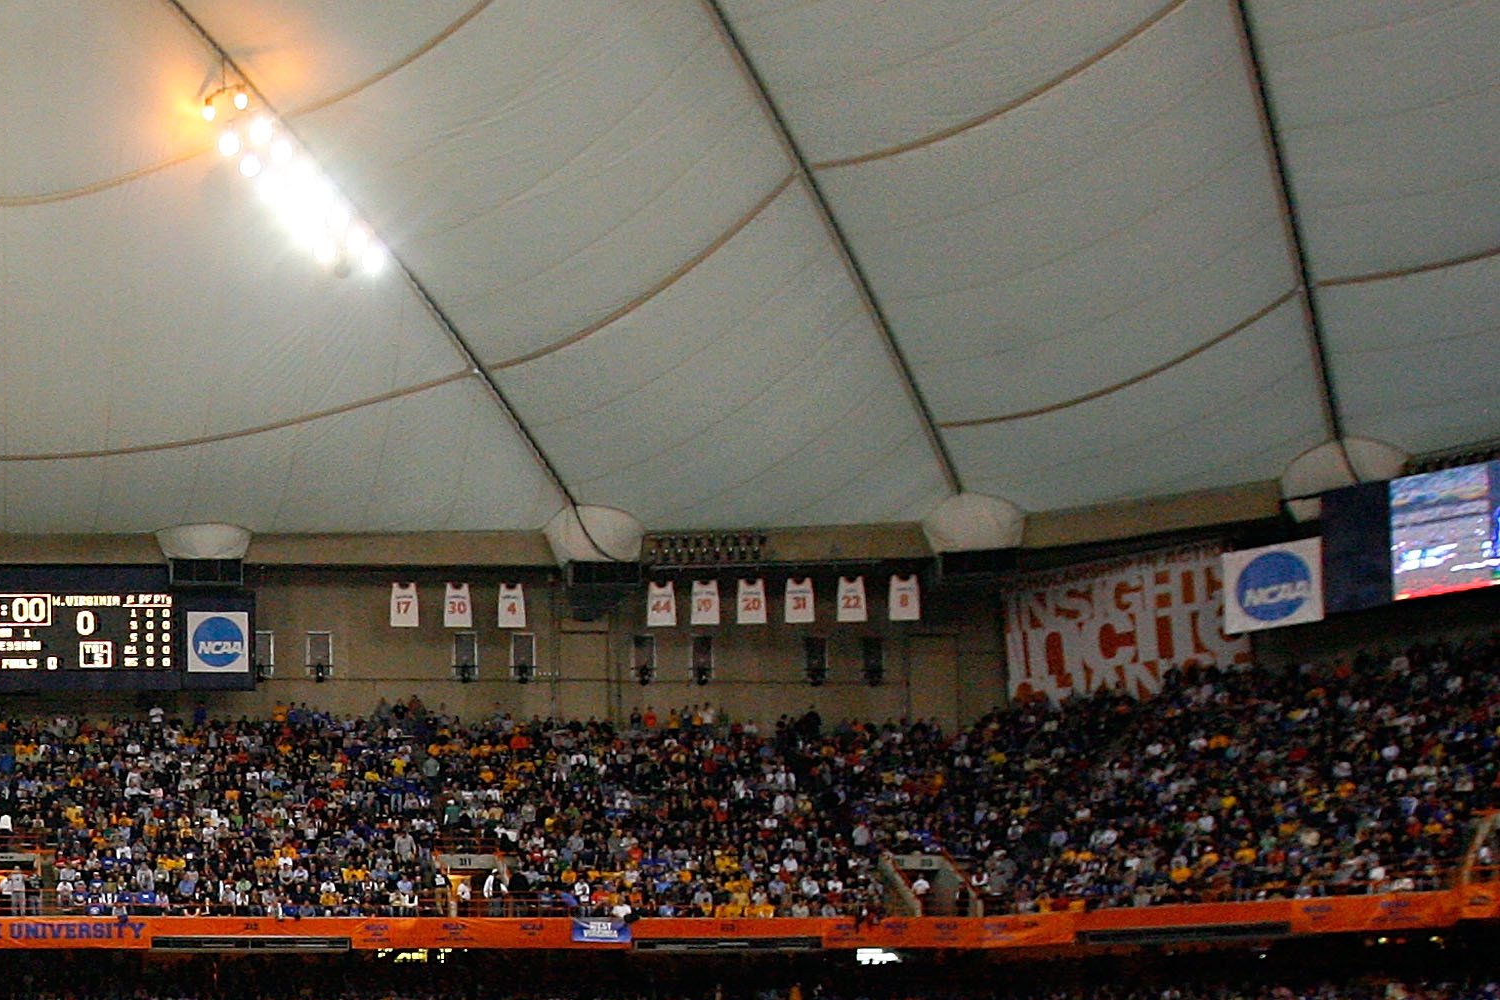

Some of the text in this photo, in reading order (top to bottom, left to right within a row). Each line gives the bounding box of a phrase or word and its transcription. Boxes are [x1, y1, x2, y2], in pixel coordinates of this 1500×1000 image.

[899, 593, 909, 607] 8
[1243, 580, 1312, 608] NCAA
[448, 601, 467, 615] 30
[506, 602, 517, 615] 4
[651, 600, 671, 613] 44
[841, 596, 862, 609] 22
[77, 610, 96, 636] 0
[23, 628, 31, 638] 1
[198, 641, 244, 655] NCAA
[46, 657, 58, 670] 0
[9, 922, 146, 938] UNIVERSITY
